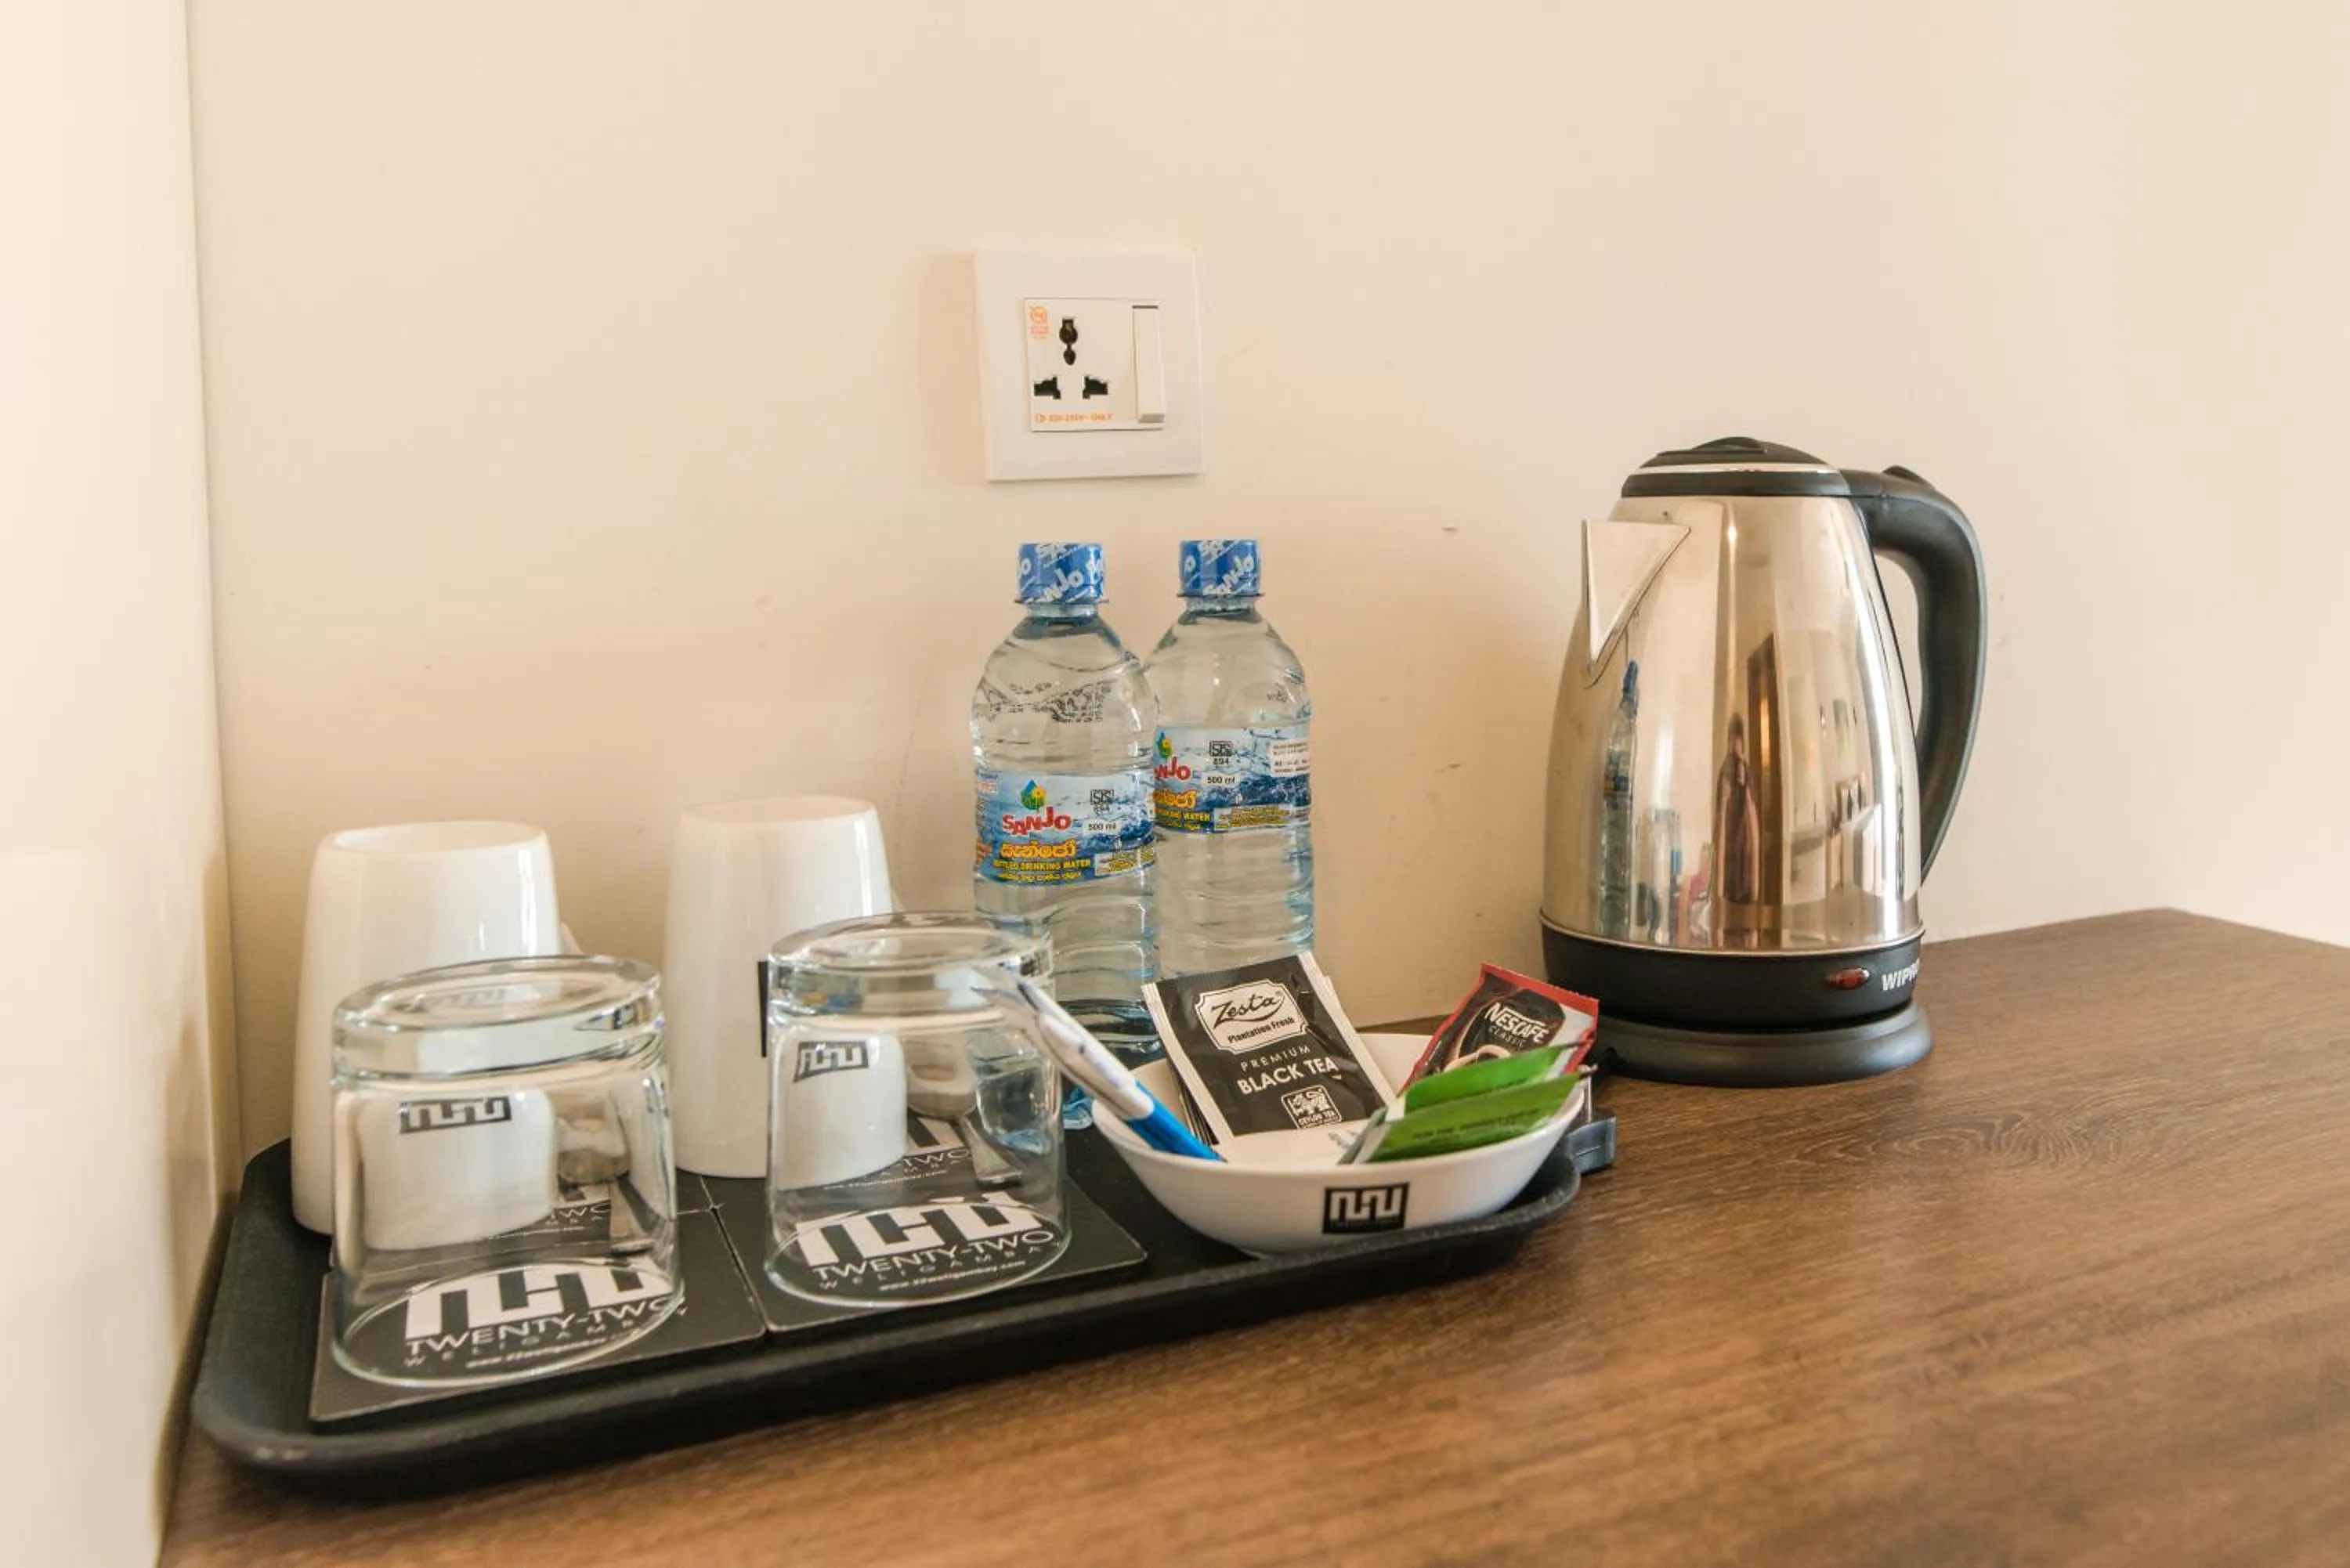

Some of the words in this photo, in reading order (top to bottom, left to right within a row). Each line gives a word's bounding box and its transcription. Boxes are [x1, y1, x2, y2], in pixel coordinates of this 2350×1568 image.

[1211, 992, 1285, 1029] Zesta
[1227, 1024, 1272, 1044] Plantation
[1271, 1017, 1296, 1034] Fresh
[1236, 1068, 1303, 1095] BLACK
[1305, 1056, 1339, 1075] TEA
[1240, 1045, 1311, 1072] PREMIUM
[813, 1230, 1054, 1280] TWENTY-TWO
